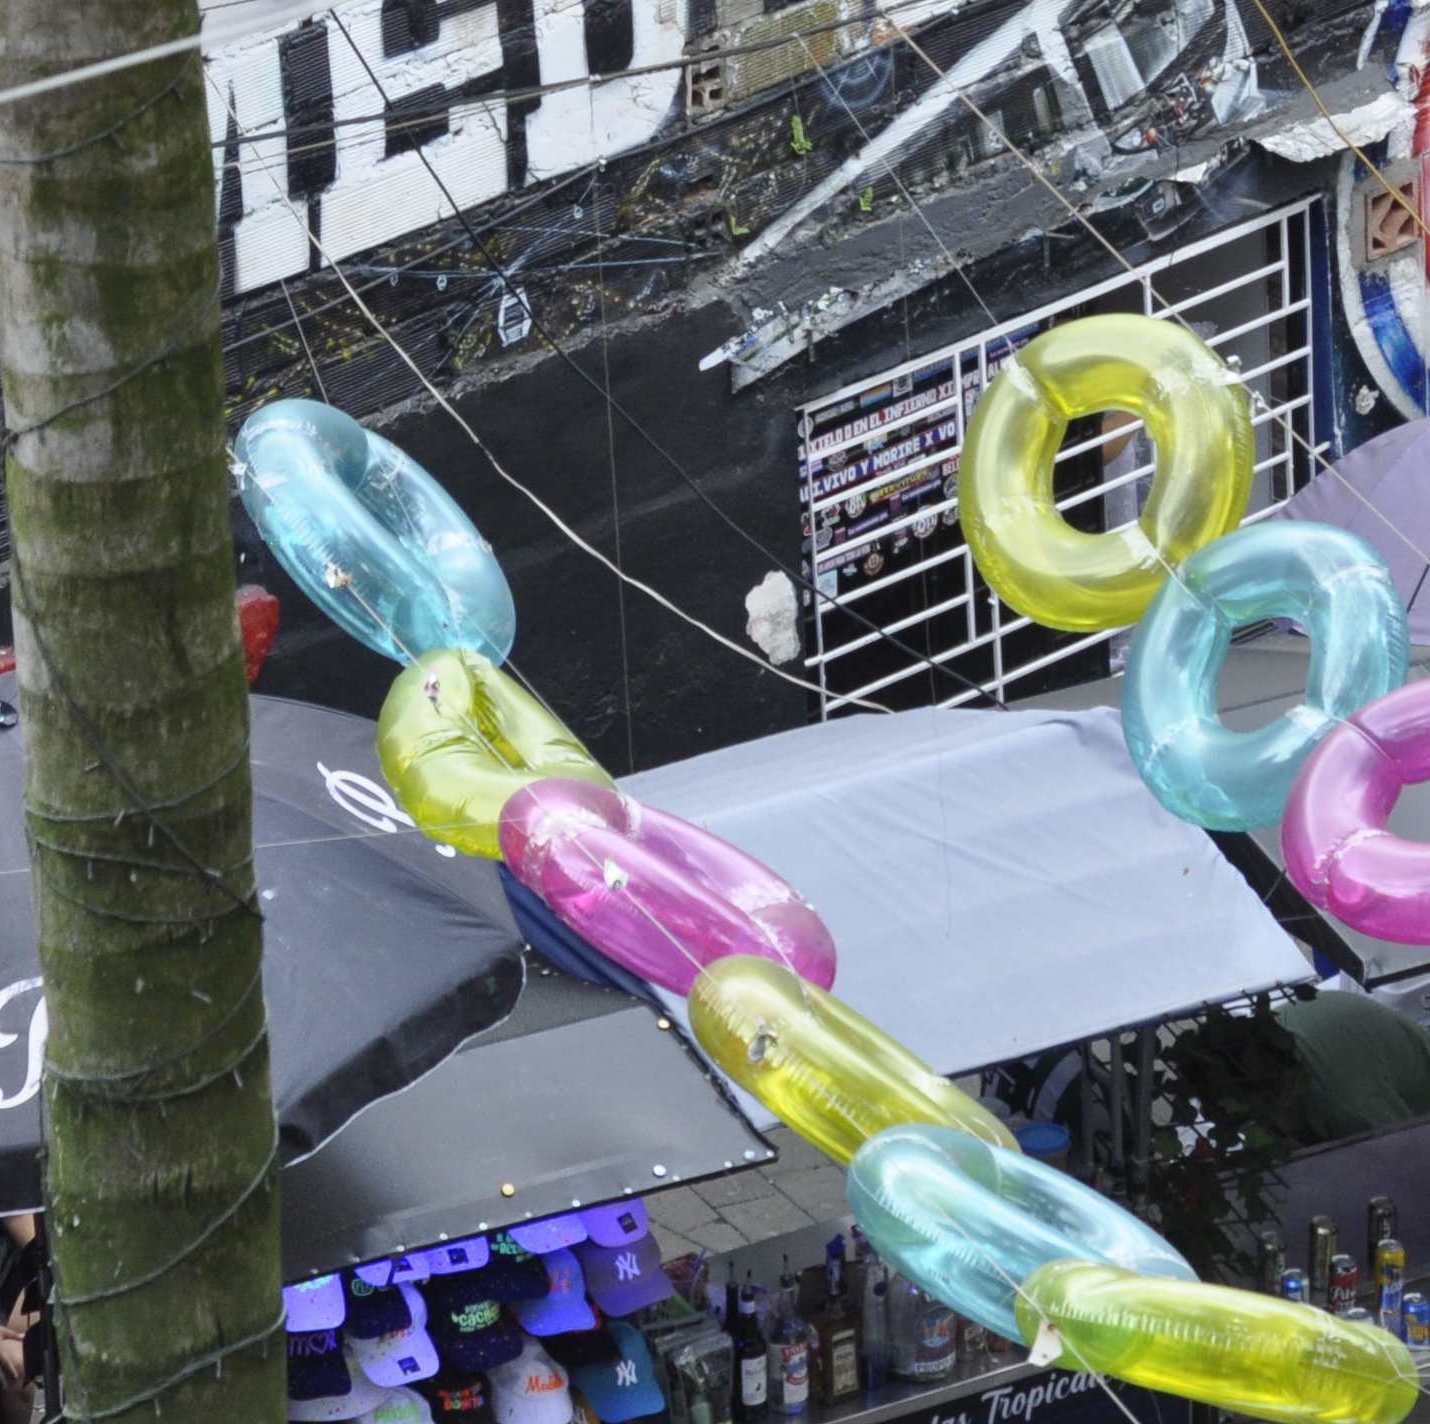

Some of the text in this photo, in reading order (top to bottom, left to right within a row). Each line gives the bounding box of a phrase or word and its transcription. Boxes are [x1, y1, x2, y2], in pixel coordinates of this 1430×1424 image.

[854, 417, 868, 437] EN
[873, 438, 921, 471] MORIRE
[925, 430, 934, 446] X
